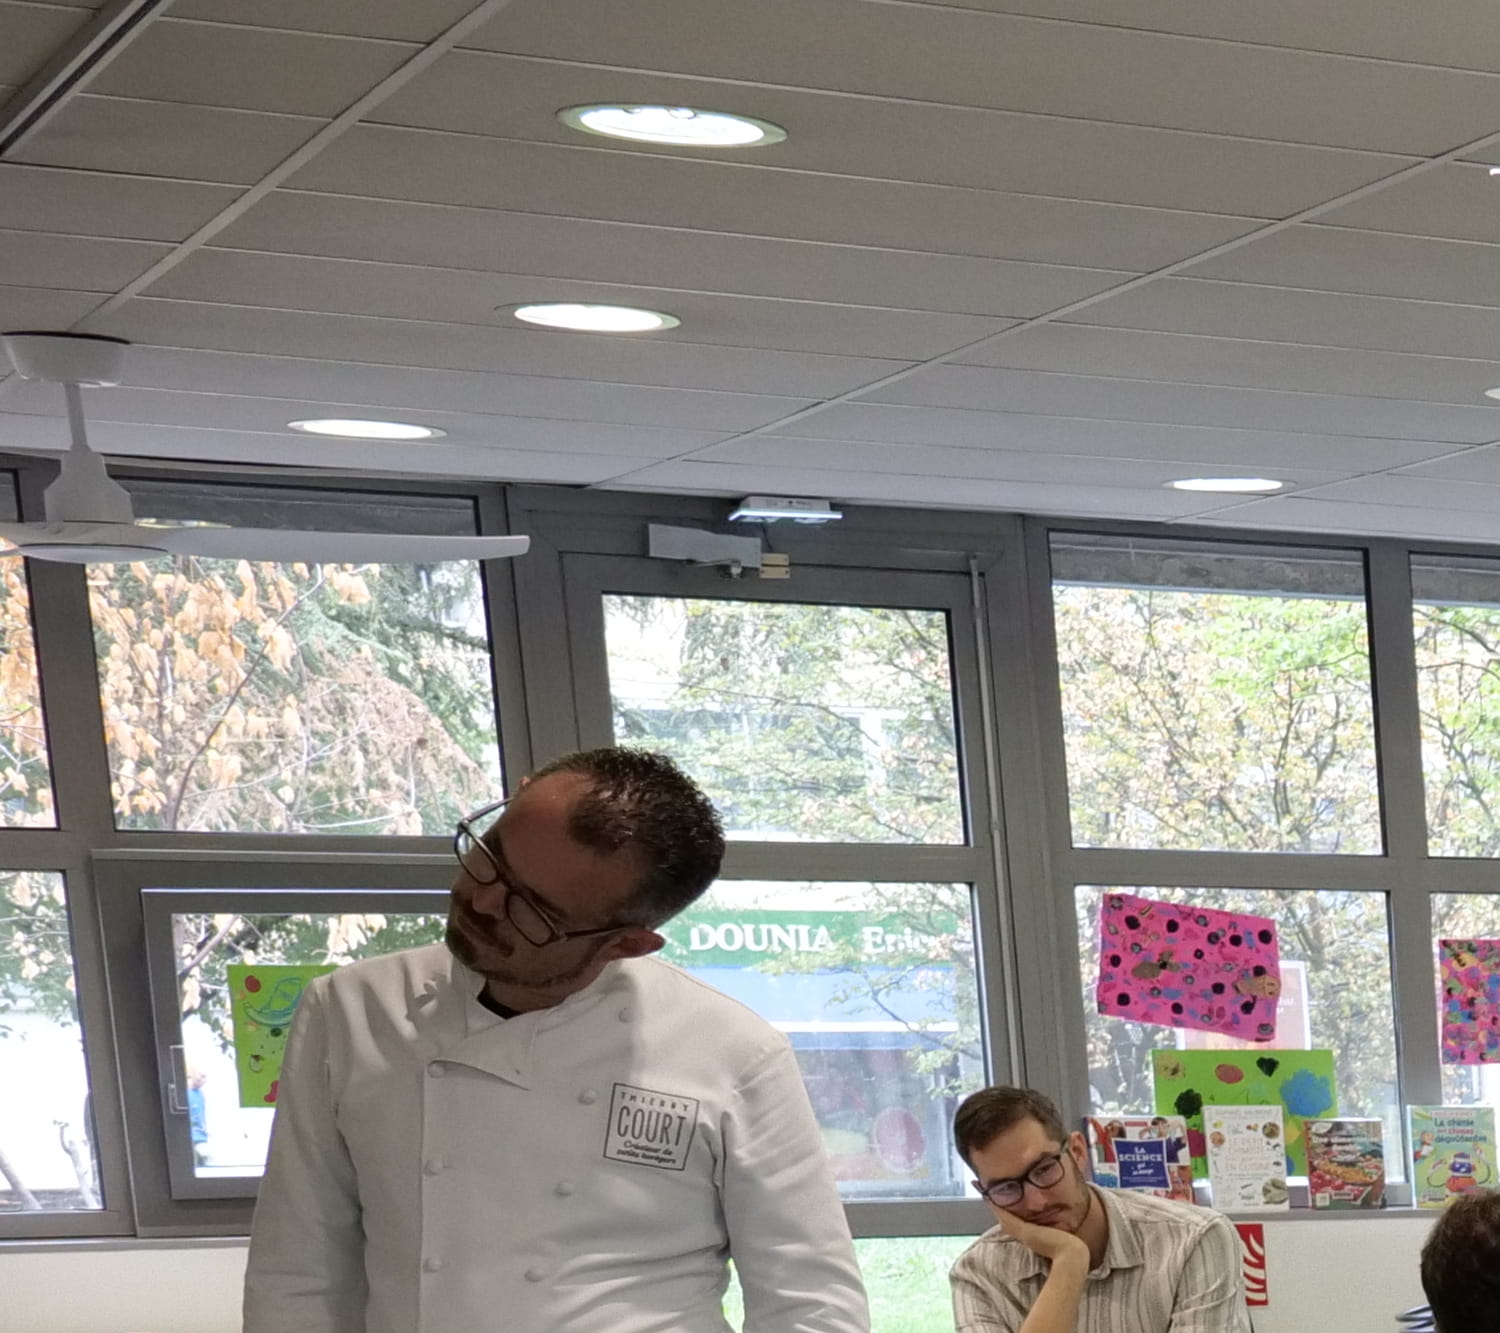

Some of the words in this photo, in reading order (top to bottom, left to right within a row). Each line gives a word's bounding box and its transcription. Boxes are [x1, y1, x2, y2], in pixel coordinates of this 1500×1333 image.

[689, 923, 836, 952] DOUNIA
[616, 1105, 687, 1147] COURT
[1119, 1153, 1163, 1162] SCIENCE
